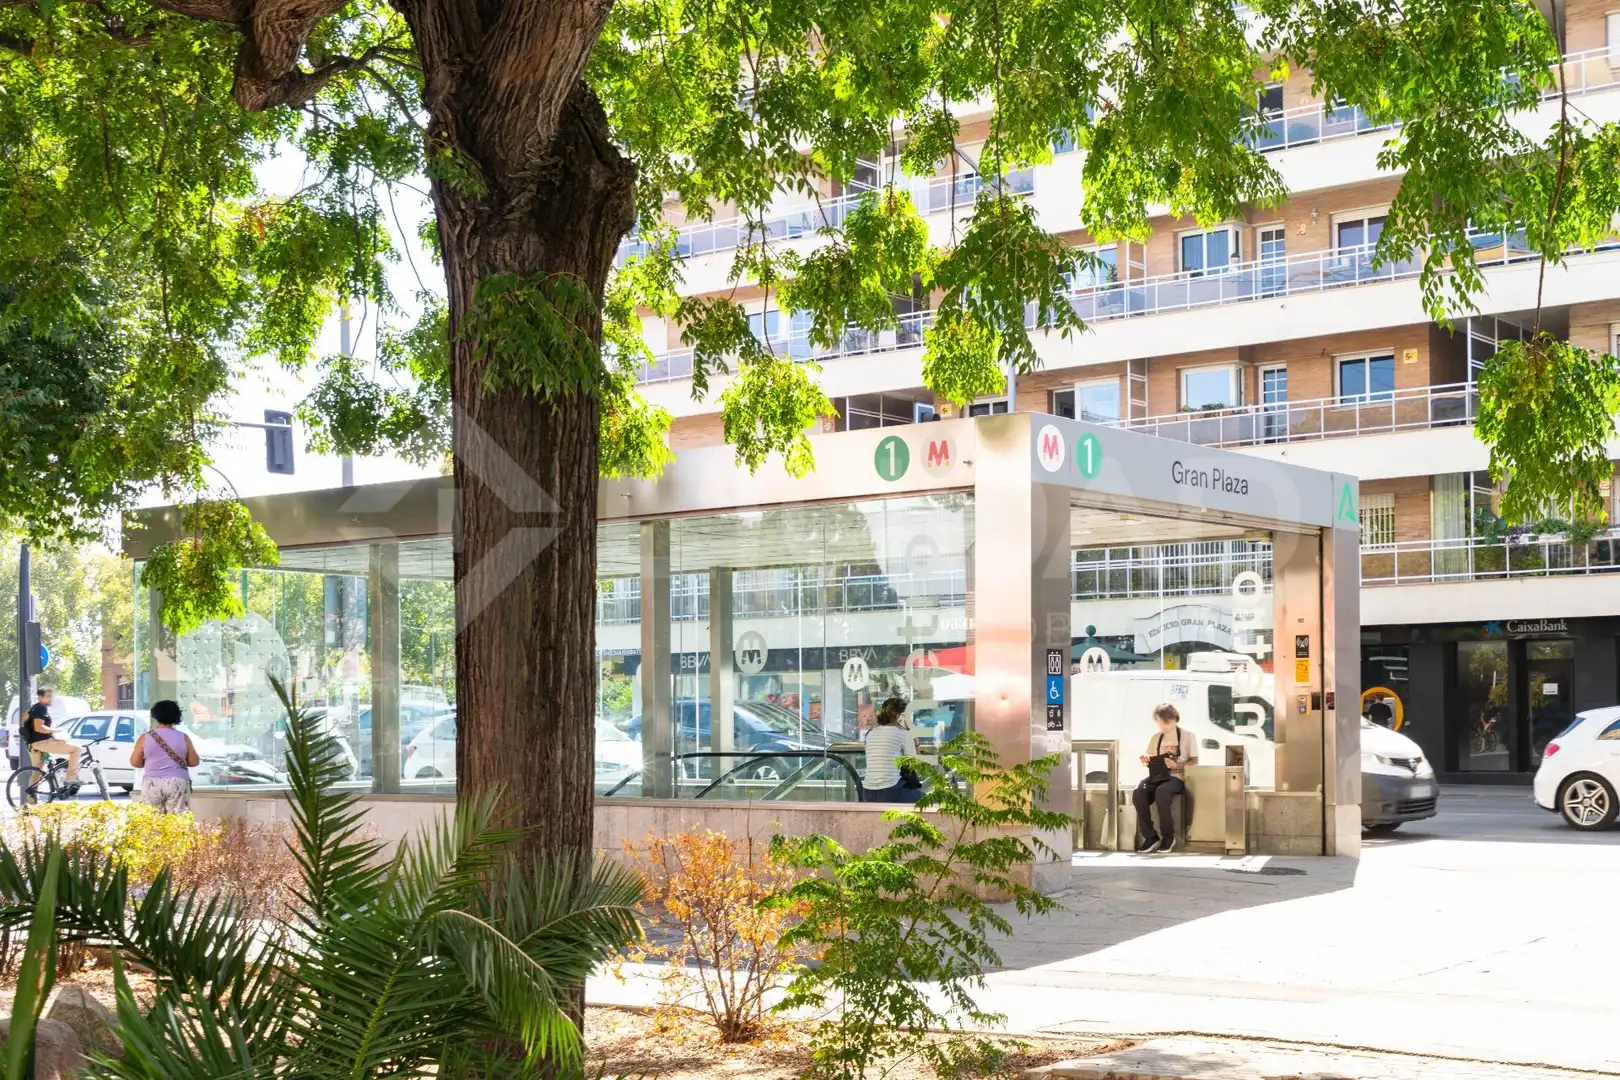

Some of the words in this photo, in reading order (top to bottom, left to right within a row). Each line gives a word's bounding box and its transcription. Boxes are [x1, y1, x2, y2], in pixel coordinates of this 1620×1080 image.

[884, 440, 896, 477] 1
[927, 439, 950, 467] M
[1042, 433, 1059, 462] M
[1083, 437, 1093, 474] 1
[1171, 460, 1208, 489] Gran
[1211, 467, 1249, 496] Plaza
[1506, 618, 1568, 633] CaixaBank
